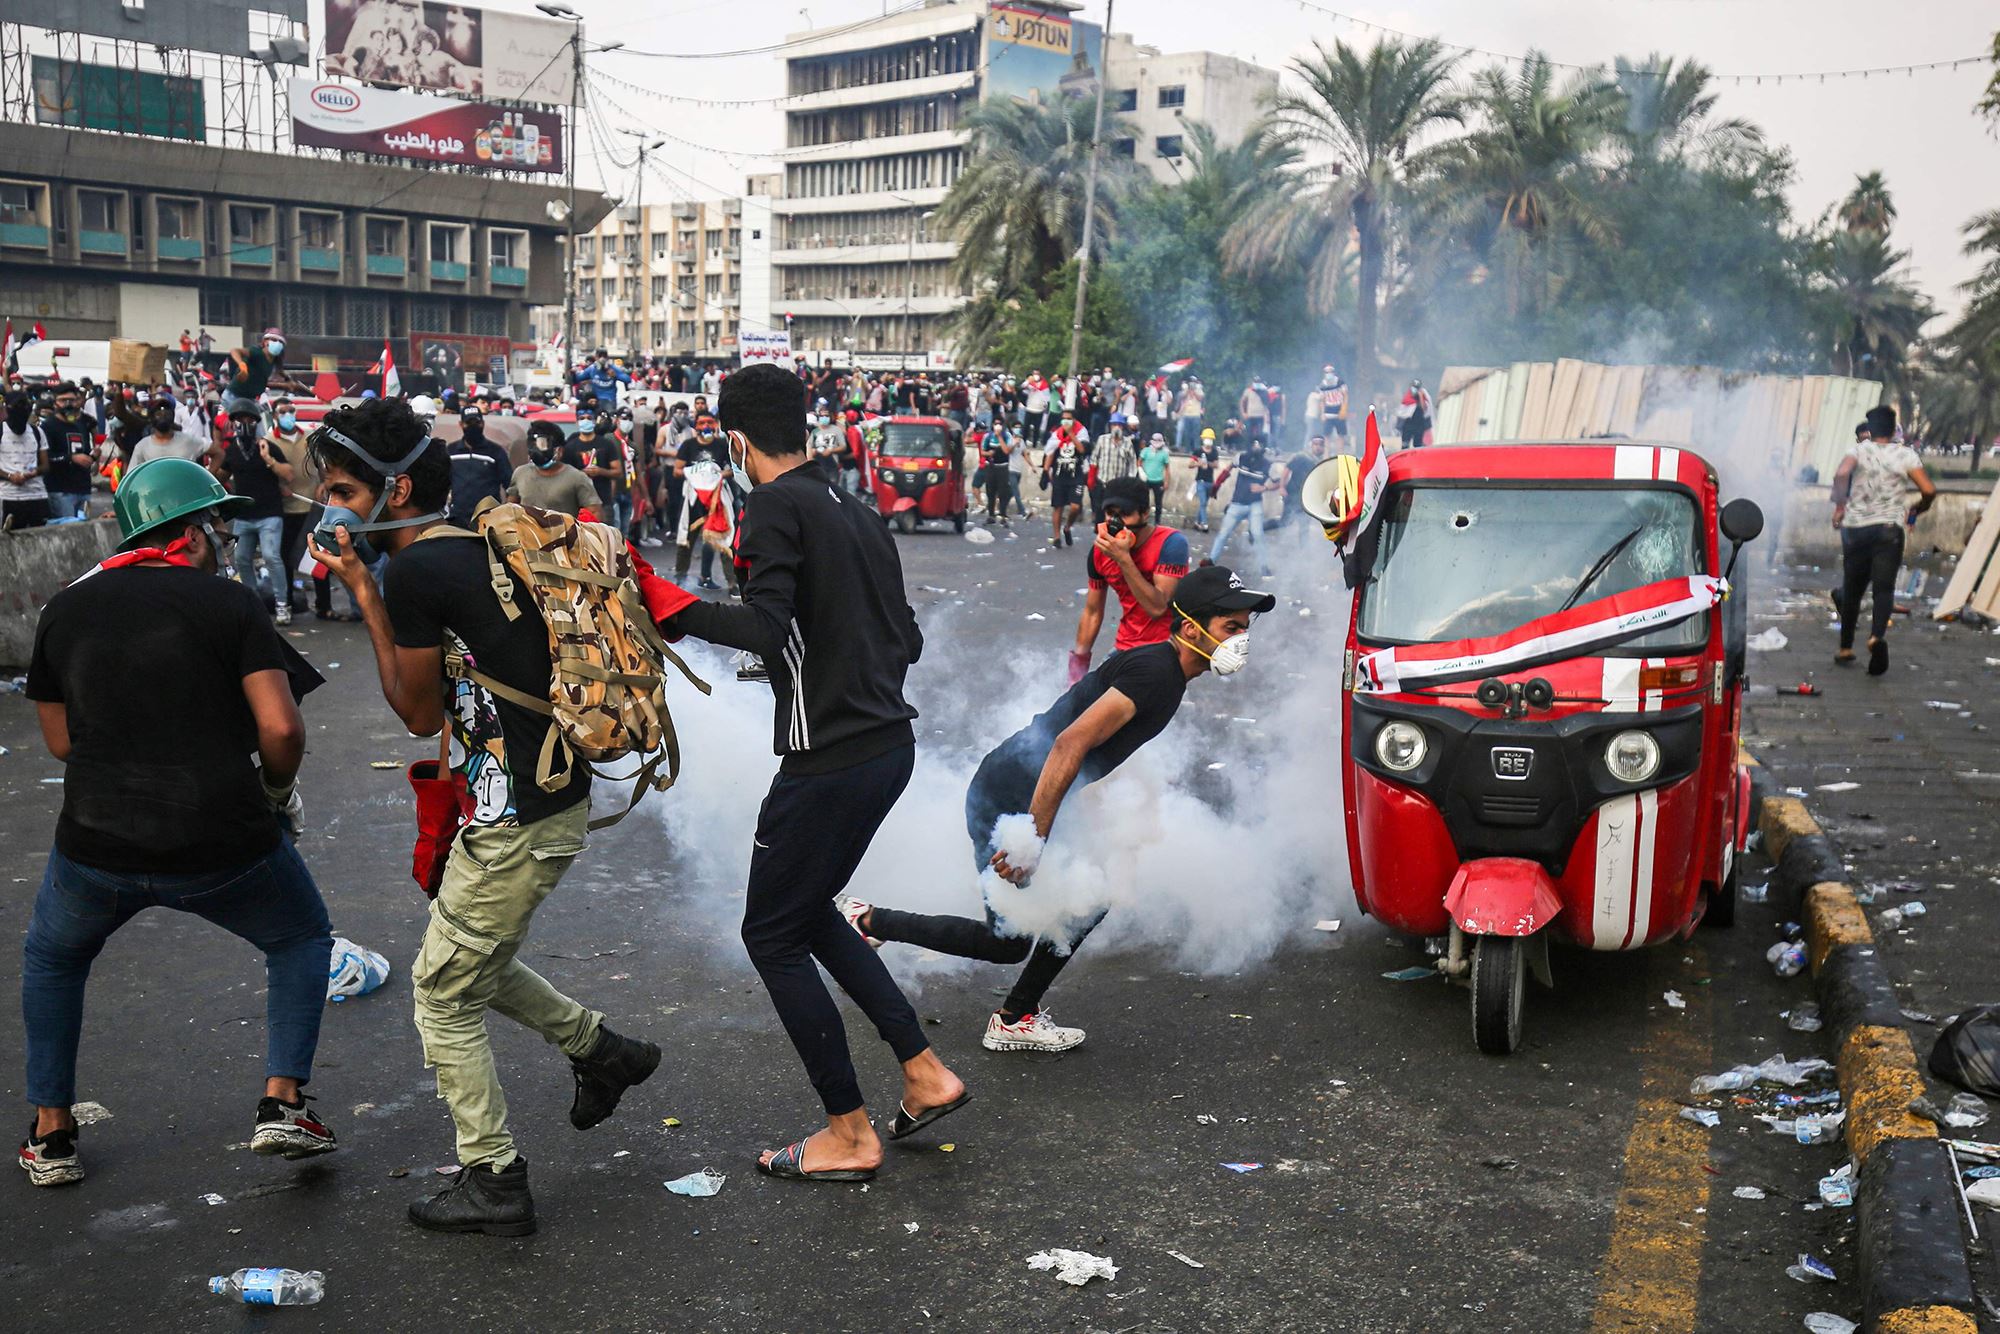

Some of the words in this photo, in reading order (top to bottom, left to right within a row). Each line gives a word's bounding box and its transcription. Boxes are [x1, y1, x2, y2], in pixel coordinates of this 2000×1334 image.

[1013, 16, 1068, 48] JOTUN
[318, 93, 354, 106] HELLO
[384, 131, 436, 154] بالطيب
[437, 136, 465, 155] هلو
[1499, 757, 1526, 772] RE
